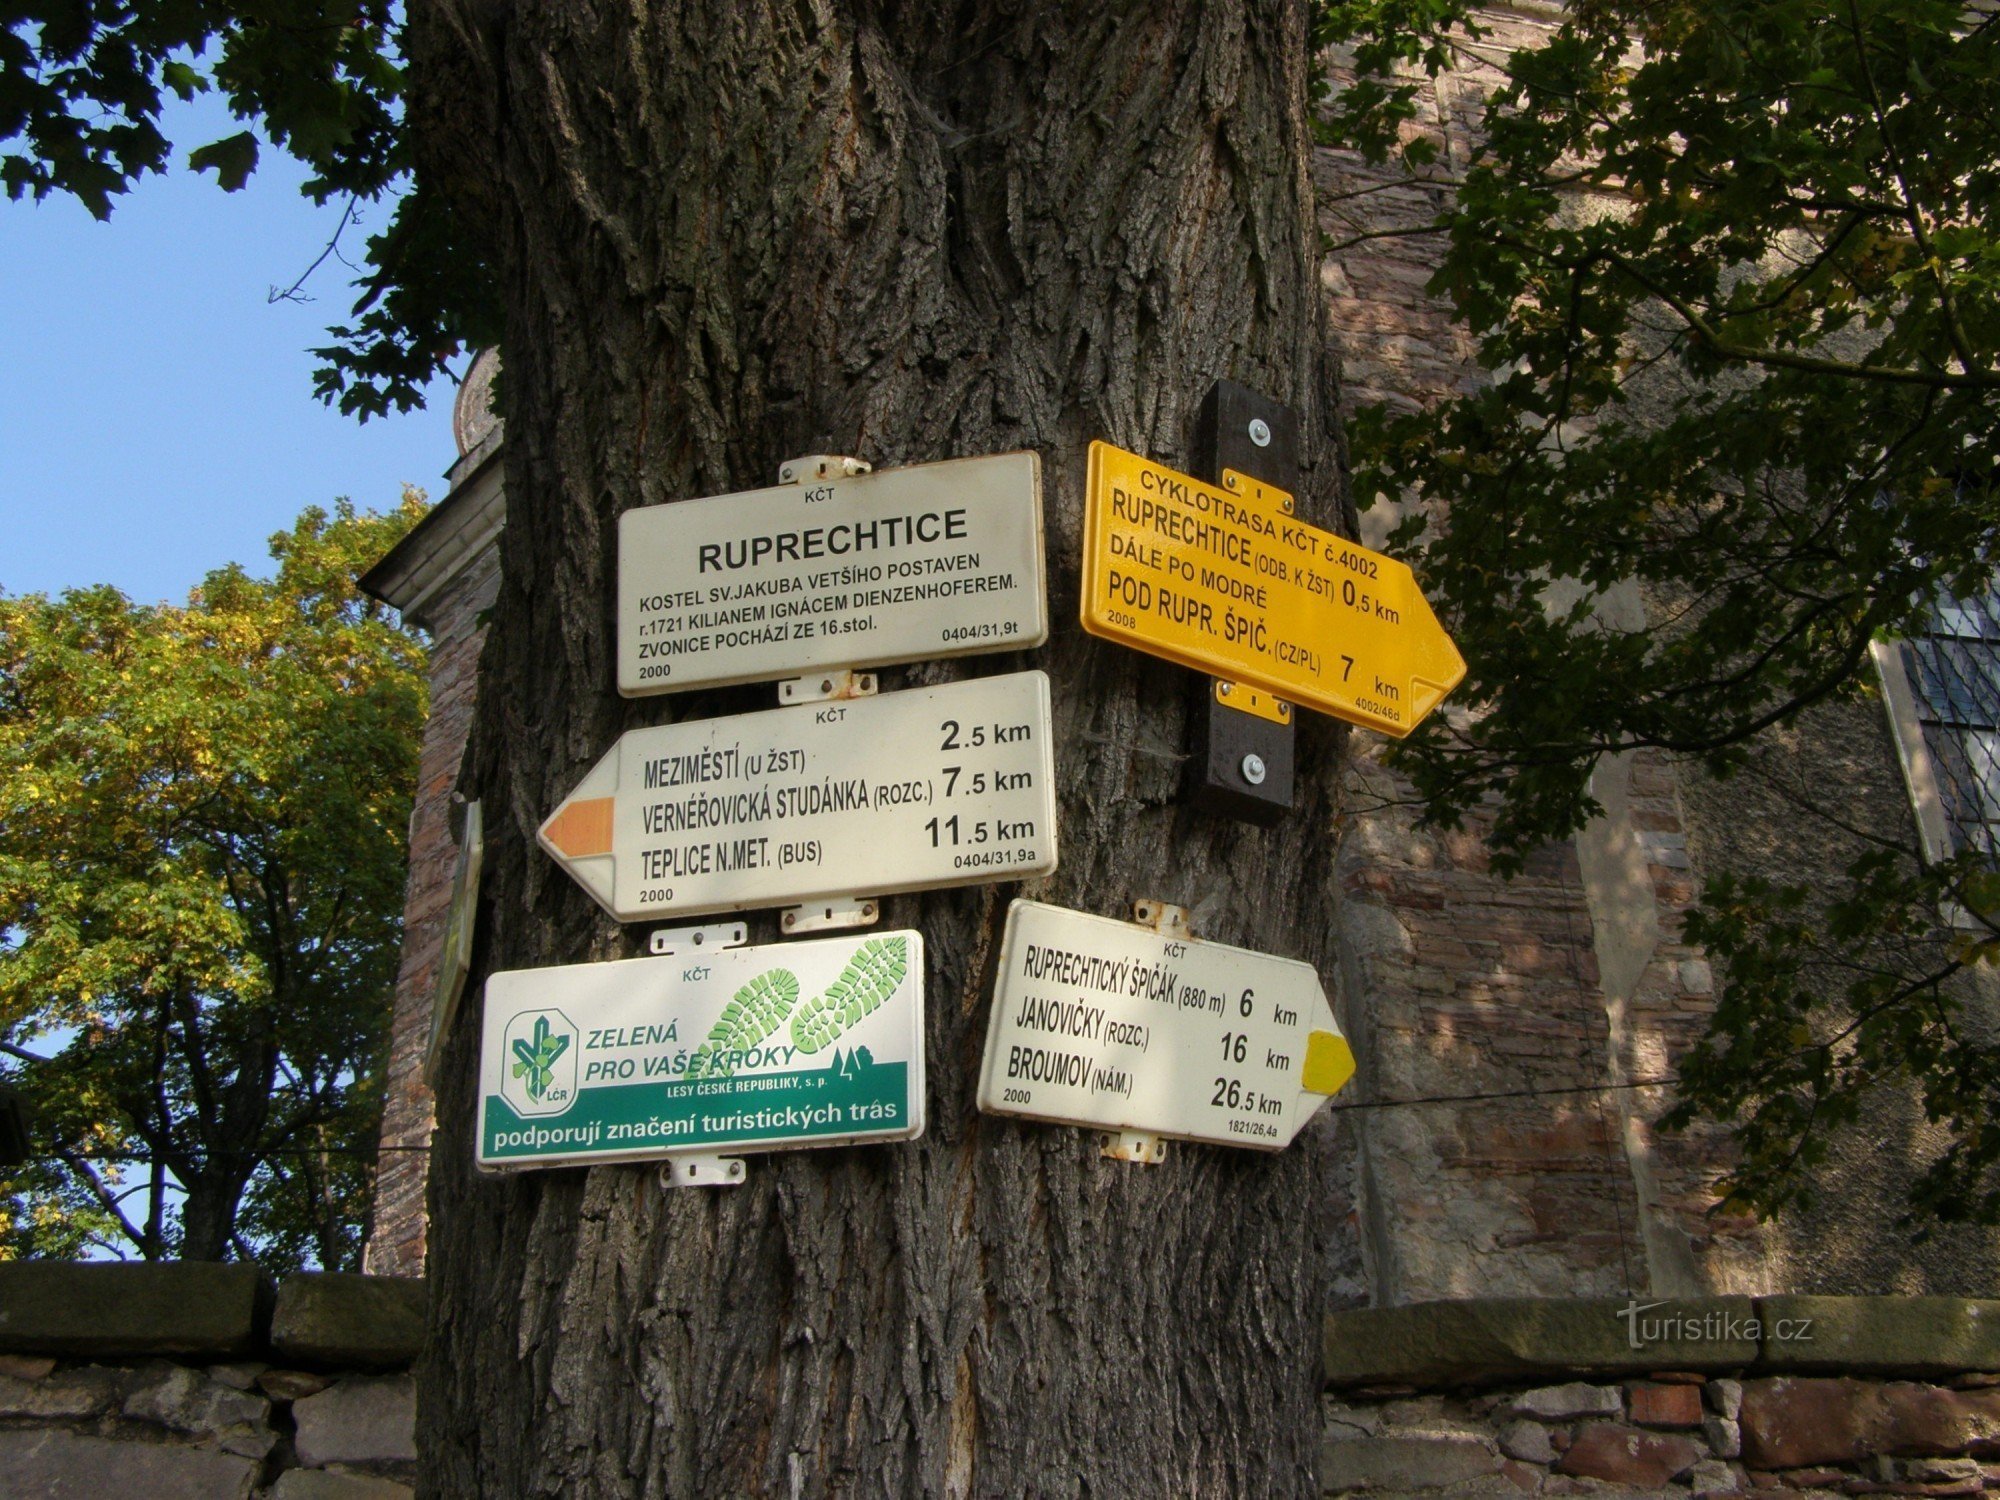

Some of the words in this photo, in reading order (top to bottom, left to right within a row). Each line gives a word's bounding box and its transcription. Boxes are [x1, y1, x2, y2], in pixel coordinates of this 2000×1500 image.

[804, 487, 835, 503] KČT
[700, 509, 967, 572] RUPRECHTICE
[1140, 469, 1276, 540] CYKLOTRASA
[1282, 525, 1319, 555] KČT
[1325, 545, 1378, 580] č.4002
[1110, 533, 1163, 570] DÁLE
[1170, 556, 1195, 581] PO
[1201, 569, 1267, 608] MODRÉ
[1113, 488, 1251, 568] RUPRECHTICE
[1255, 552, 1291, 582] (ODB.
[1295, 568, 1304, 587] K
[1308, 569, 1335, 604] ŽST)
[1342, 579, 1370, 612] 0,5
[1376, 600, 1400, 625] km
[639, 591, 704, 612] KOSTEL
[808, 565, 882, 589] VETŠÍHO
[887, 553, 981, 578] POSTAVEN
[639, 617, 684, 636] r.1721
[688, 599, 764, 630] KILIANEM
[770, 589, 848, 618] IGNÁCEM
[853, 573, 1018, 609] DIENZENHOFEREM.
[1107, 609, 1137, 629] 2008
[639, 634, 710, 658] ZVONICE
[715, 621, 789, 652] POCHÁZÍ
[793, 623, 814, 639] ZE
[819, 615, 877, 635] 16.stol.
[941, 621, 1019, 642] 0404/31,9t
[1109, 570, 1152, 611] POD
[1159, 588, 1218, 637] RUPR.
[1224, 602, 1272, 655] ŠPIČ.
[1274, 639, 1321, 677] (CZ/PL)
[1341, 655, 1354, 682] 7
[1375, 675, 1399, 701] km
[639, 663, 671, 679] 2000
[816, 708, 847, 724] KČT
[1355, 697, 1400, 721] 4002/46d
[644, 742, 739, 789] MEZIMĚSTÍ
[744, 755, 762, 780] (U
[767, 748, 805, 774] ŽST)
[940, 719, 986, 752] 2.5
[994, 721, 1031, 745] km
[643, 783, 771, 834] VERNÉŘOVICKÁ
[776, 777, 869, 818] STUDÁNKA
[873, 780, 933, 813] (ROZC.)
[941, 766, 986, 798] 7.5
[996, 770, 1033, 793] km
[642, 844, 711, 880] TEPLICE
[716, 838, 770, 872] N.MET.
[778, 840, 822, 870] (BUS)
[924, 815, 988, 848] 11.5
[997, 818, 1035, 841] km
[953, 850, 1036, 869] 0404/31,9a
[639, 887, 673, 904] 2000
[1164, 943, 1187, 959] KČT
[683, 968, 711, 982] KČT
[1024, 944, 1130, 995] RUPRECHTICKÝ
[1129, 958, 1177, 1004] ŠPIČÁK
[1178, 985, 1205, 1011] (880
[1209, 992, 1225, 1018] m)
[1239, 989, 1254, 1017] 6
[1273, 1004, 1298, 1026] km
[586, 1019, 679, 1049] ZELENÁ
[1017, 996, 1105, 1040] JANOVIČKY
[1104, 1020, 1150, 1053] (ROZC.)
[1220, 1032, 1247, 1063] 16
[1266, 1049, 1290, 1070] km
[585, 1059, 635, 1080] PRO
[642, 1050, 700, 1077] VAŠE
[709, 1044, 797, 1074] KROKY
[1008, 1045, 1093, 1088] BROUMOV
[1091, 1066, 1133, 1100] (NÁM.)
[1211, 1077, 1254, 1111] 26.5
[1259, 1093, 1282, 1115] km
[547, 1088, 568, 1102] LČR
[667, 1085, 694, 1098] LESY
[697, 1079, 733, 1095] ČESKÉ
[736, 1077, 802, 1093] REPUBLIKY,
[805, 1077, 815, 1087] s.
[818, 1077, 827, 1088] p.
[1004, 1089, 1030, 1104] 2000
[494, 1120, 600, 1151] podporují
[606, 1112, 695, 1140] značení
[701, 1101, 842, 1135] turistických
[1228, 1120, 1278, 1137] 1821/26,4a
